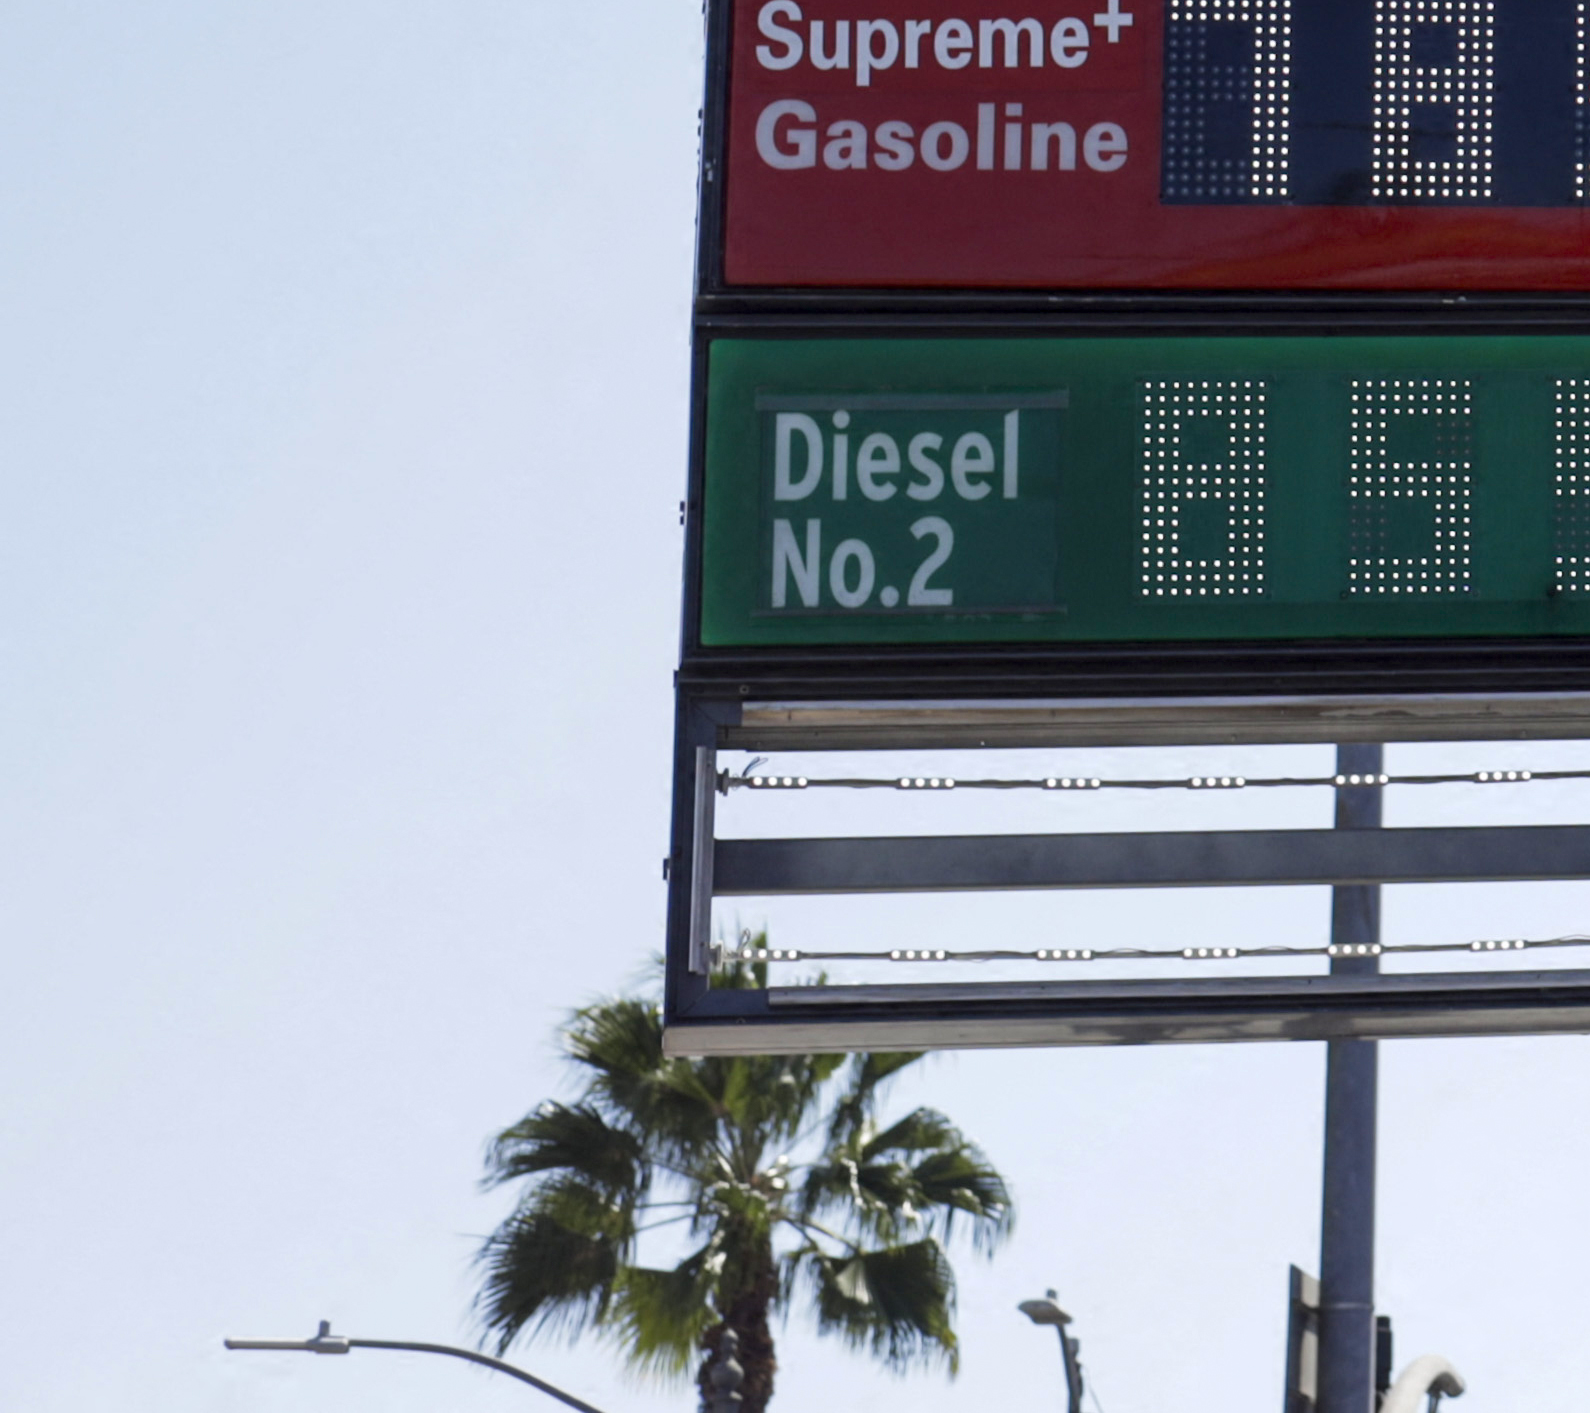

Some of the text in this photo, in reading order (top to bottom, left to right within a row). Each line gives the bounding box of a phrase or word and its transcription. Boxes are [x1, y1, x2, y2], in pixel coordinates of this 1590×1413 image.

[756, 100, 1127, 171] Gasoline
[775, 410, 1018, 501] Diesel
[772, 517, 953, 608] No.2
